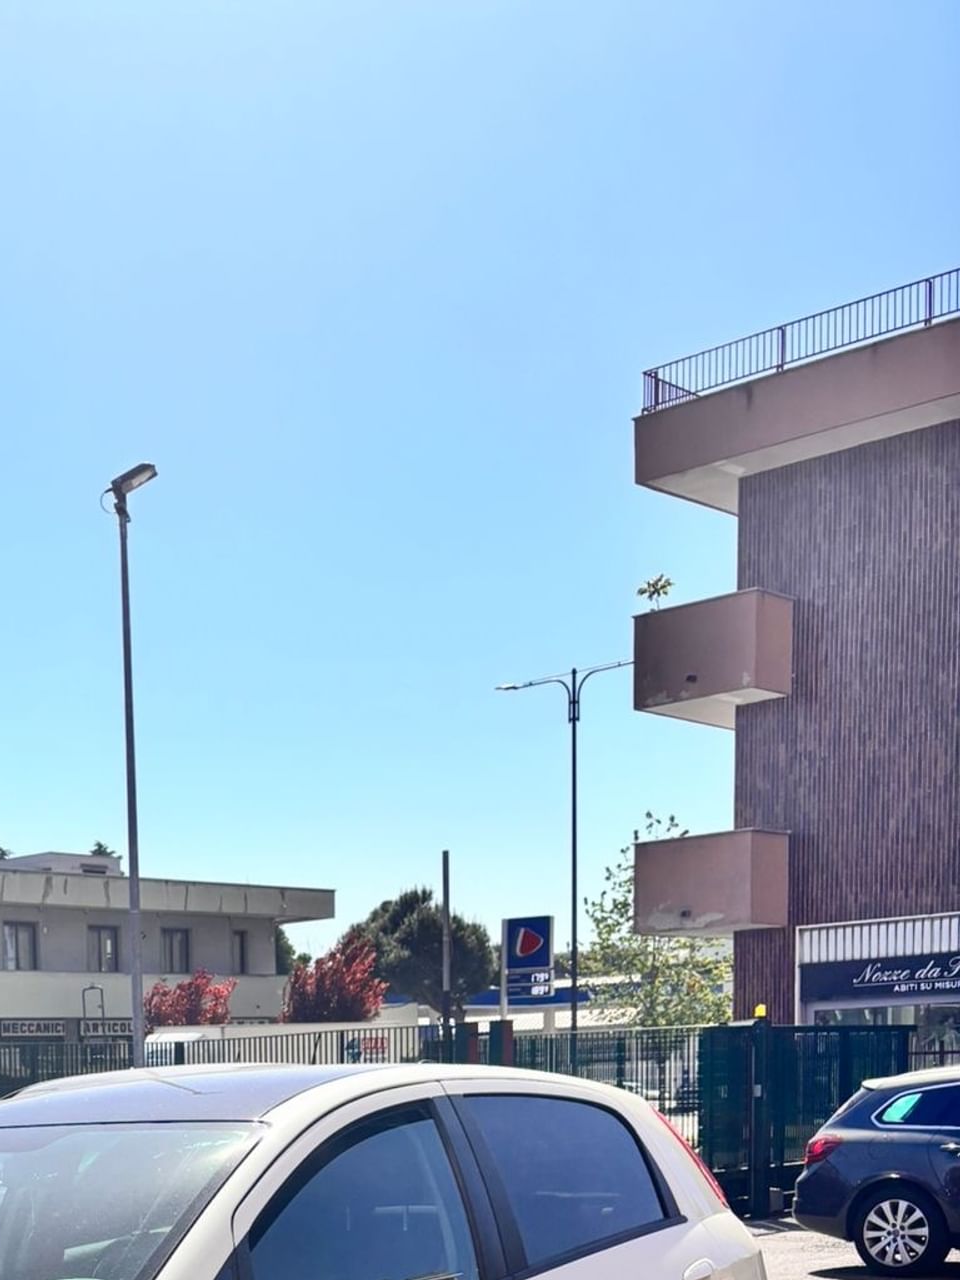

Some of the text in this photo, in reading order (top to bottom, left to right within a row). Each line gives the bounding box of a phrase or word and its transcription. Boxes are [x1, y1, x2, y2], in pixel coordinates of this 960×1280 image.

[852, 962, 910, 984] Nozze
[914, 960, 942, 979] da
[893, 983, 918, 992] ABITI
[920, 982, 932, 990] SU
[2, 1021, 64, 1034] MECCANICI
[83, 1020, 134, 1033] ARTICOL
